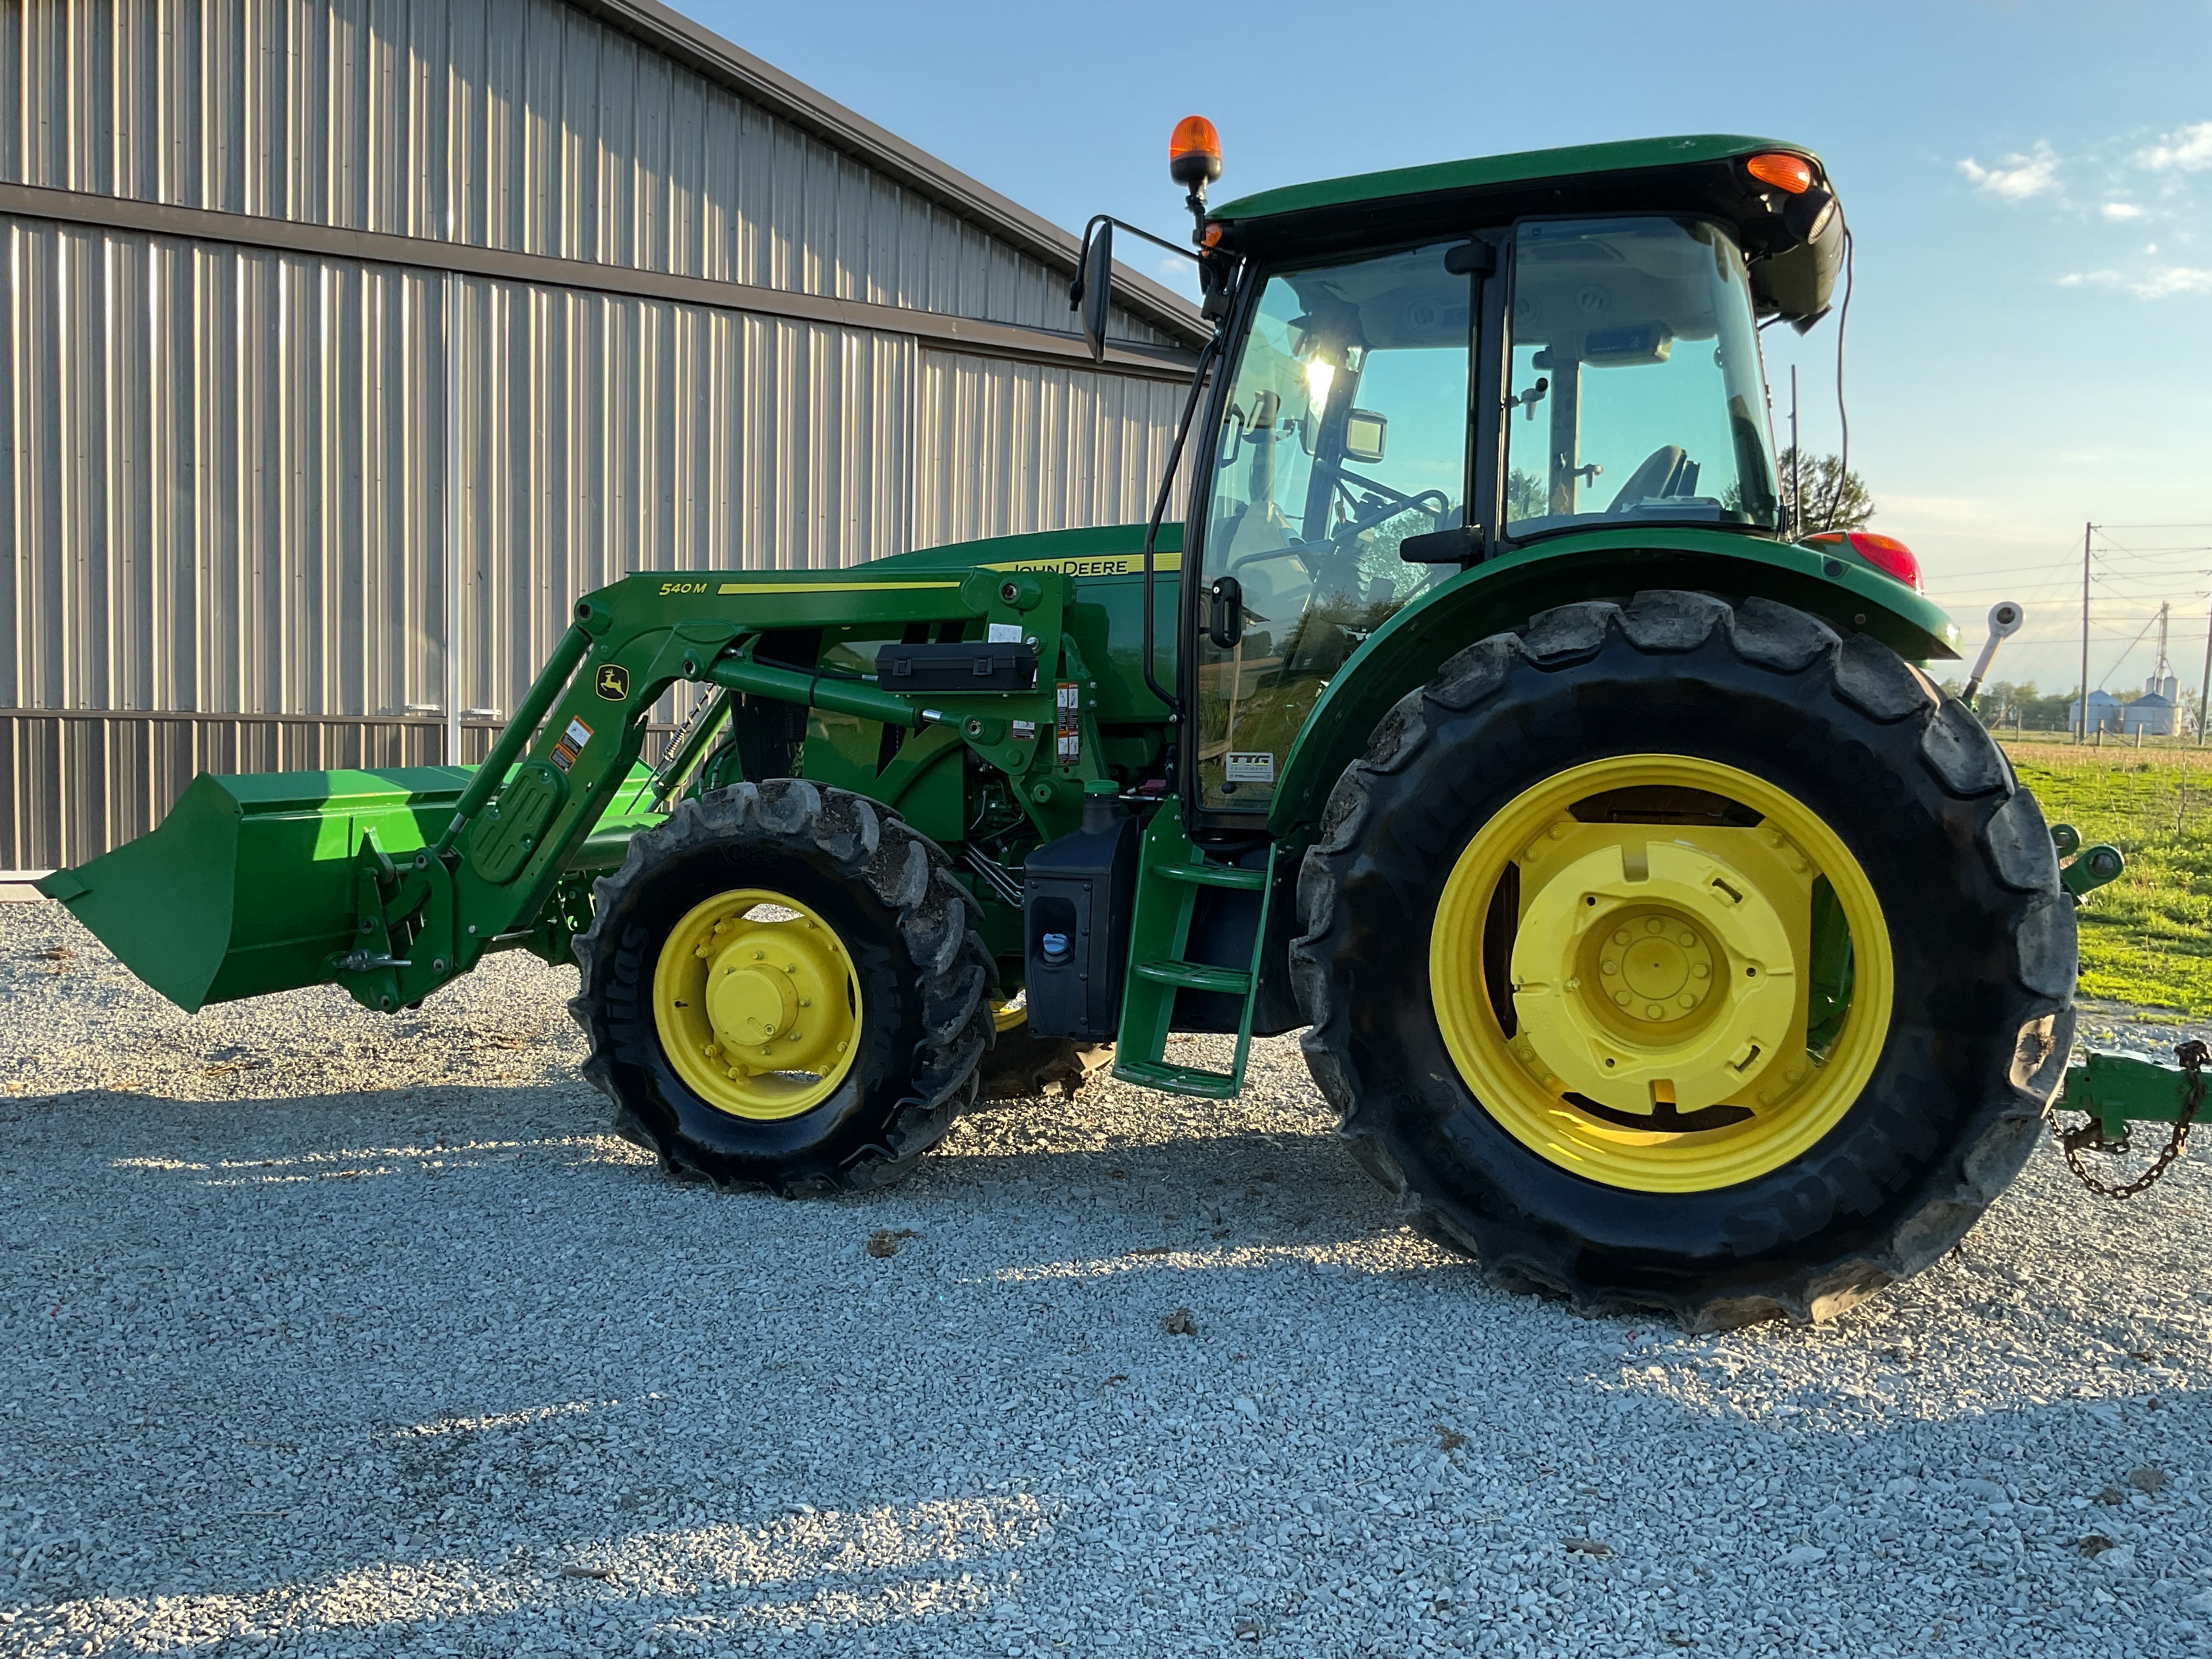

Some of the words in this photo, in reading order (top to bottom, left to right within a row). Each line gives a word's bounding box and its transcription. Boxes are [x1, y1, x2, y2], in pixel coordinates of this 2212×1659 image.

[1064, 561, 1127, 575] DEERE
[1229, 755, 1270, 766] TTG
[606, 923, 656, 1073] Mitas
